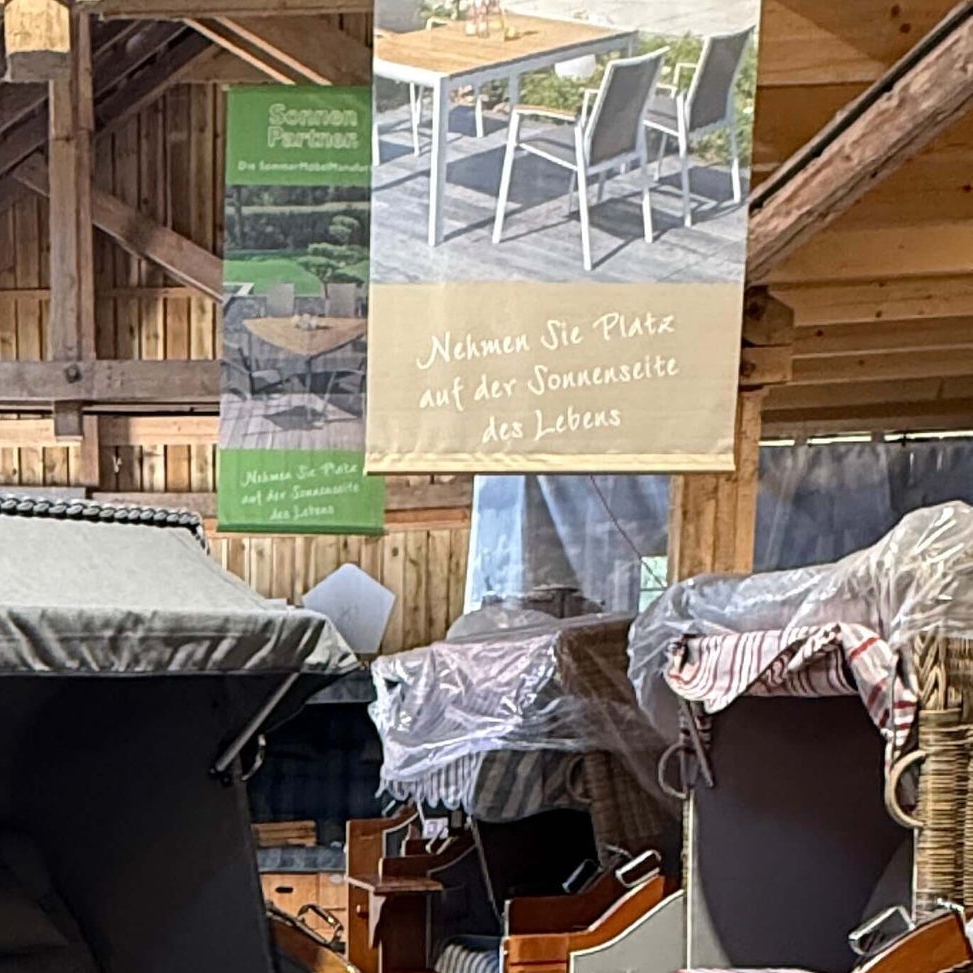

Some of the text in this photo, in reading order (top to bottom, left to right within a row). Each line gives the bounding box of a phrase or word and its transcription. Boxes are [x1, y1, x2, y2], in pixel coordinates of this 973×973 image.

[268, 103, 358, 126] Sonnen
[416, 311, 676, 370] Nehmen Sie Platz
[418, 354, 680, 412] auf der Sonnenseite
[481, 406, 622, 444] des Lebens
